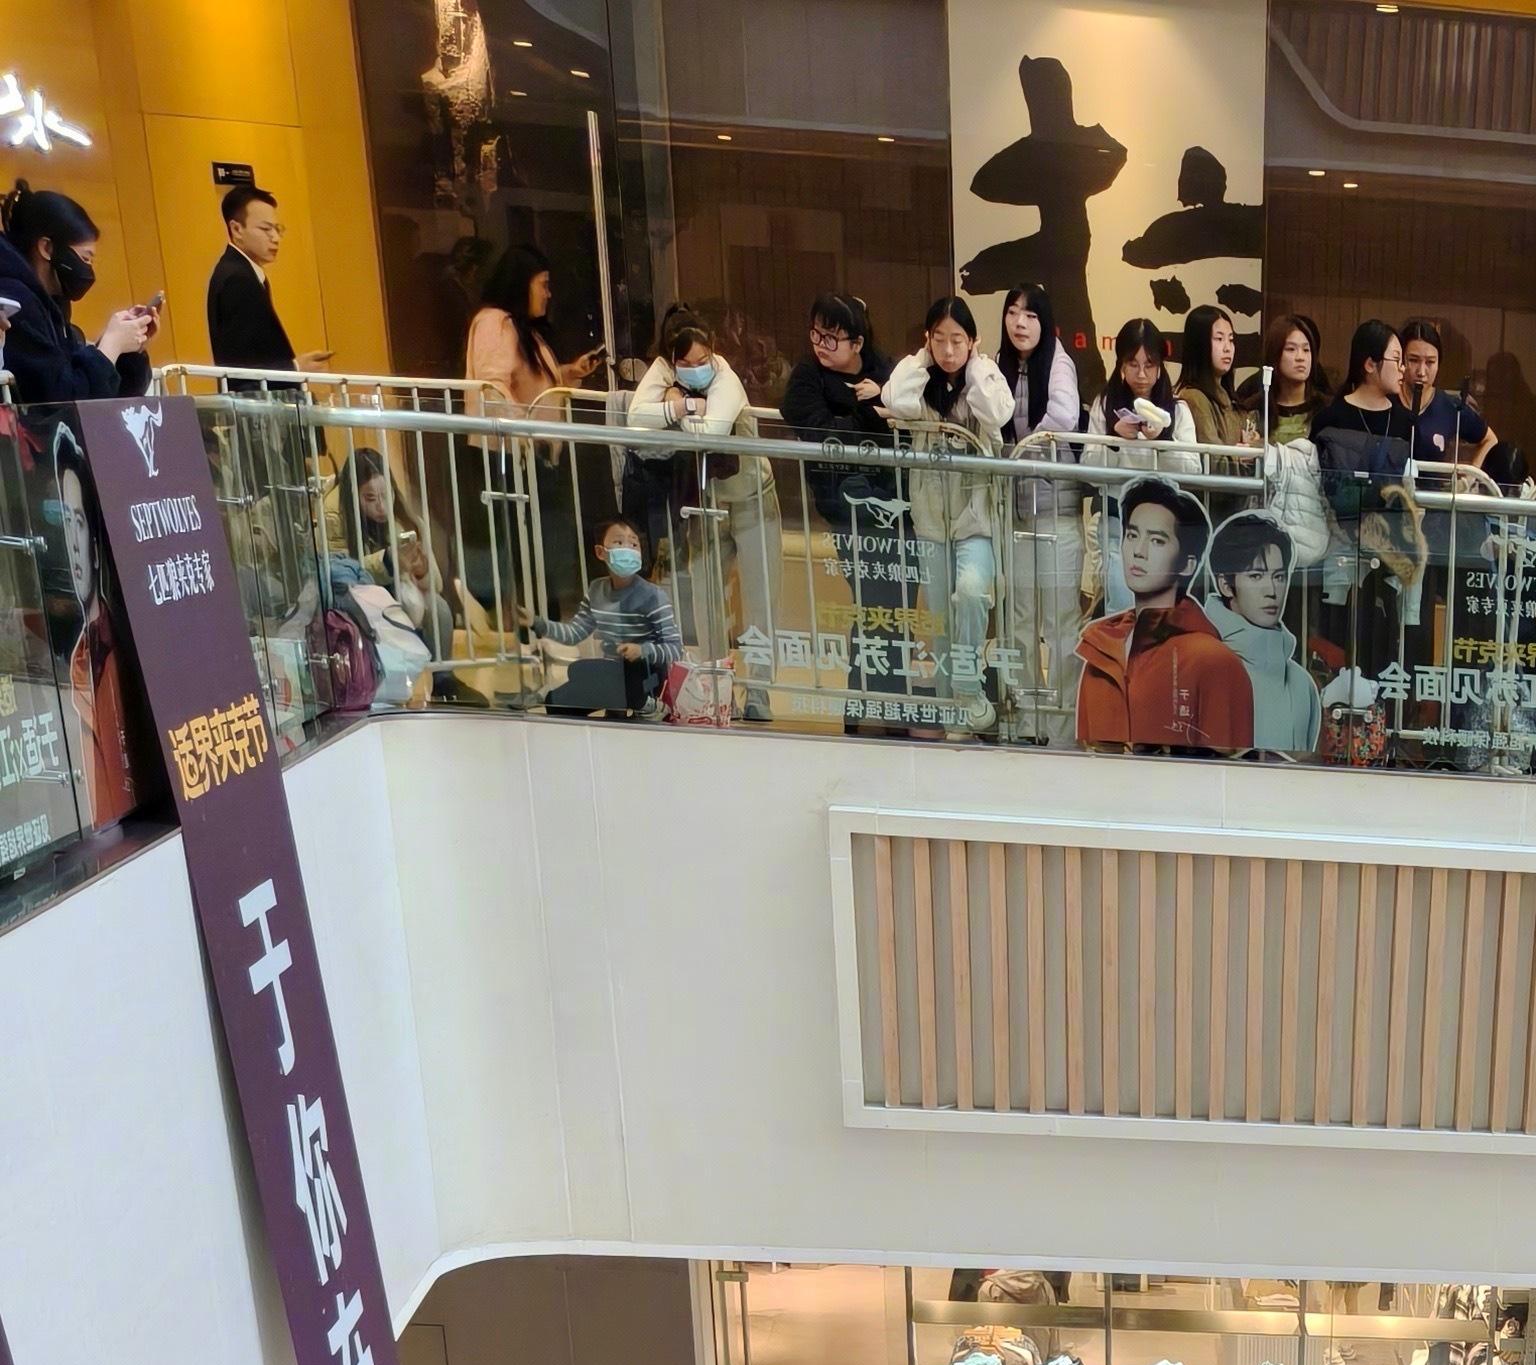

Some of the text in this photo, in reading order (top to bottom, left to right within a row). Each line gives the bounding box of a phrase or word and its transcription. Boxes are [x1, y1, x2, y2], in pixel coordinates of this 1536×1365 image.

[131, 497, 201, 543] SEPTWOLVES
[148, 550, 215, 608] 七匹狼夹克专家
[168, 695, 270, 800] 适界夹克节
